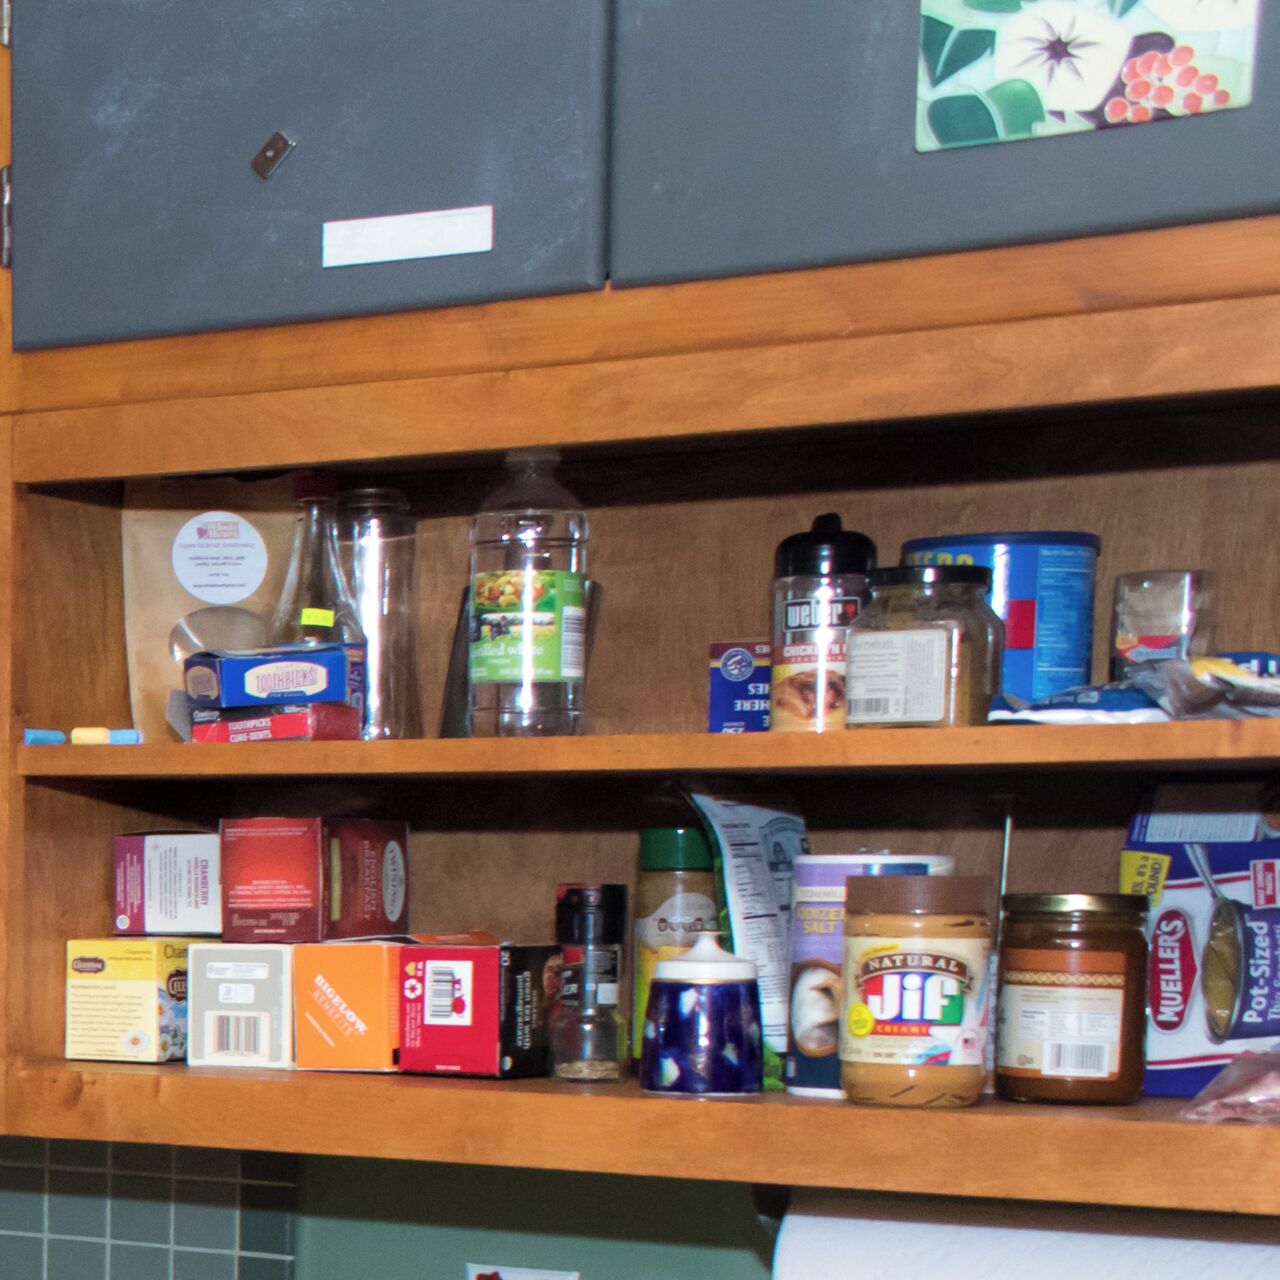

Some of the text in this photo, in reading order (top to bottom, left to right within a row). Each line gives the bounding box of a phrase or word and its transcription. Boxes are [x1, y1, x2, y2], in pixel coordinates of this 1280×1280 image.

[787, 602, 842, 627] webr
[1146, 858, 1164, 896] OUND!
[802, 921, 837, 934] SALT
[868, 955, 960, 972] NATURAL
[1156, 918, 1186, 1022] MUELLER'S
[1242, 920, 1270, 1023] Pot-Sized
[523, 971, 532, 1001] green
[313, 973, 368, 1036] BIGELOW
[516, 975, 525, 1047] pomegranate
[523, 1025, 531, 1049] with
